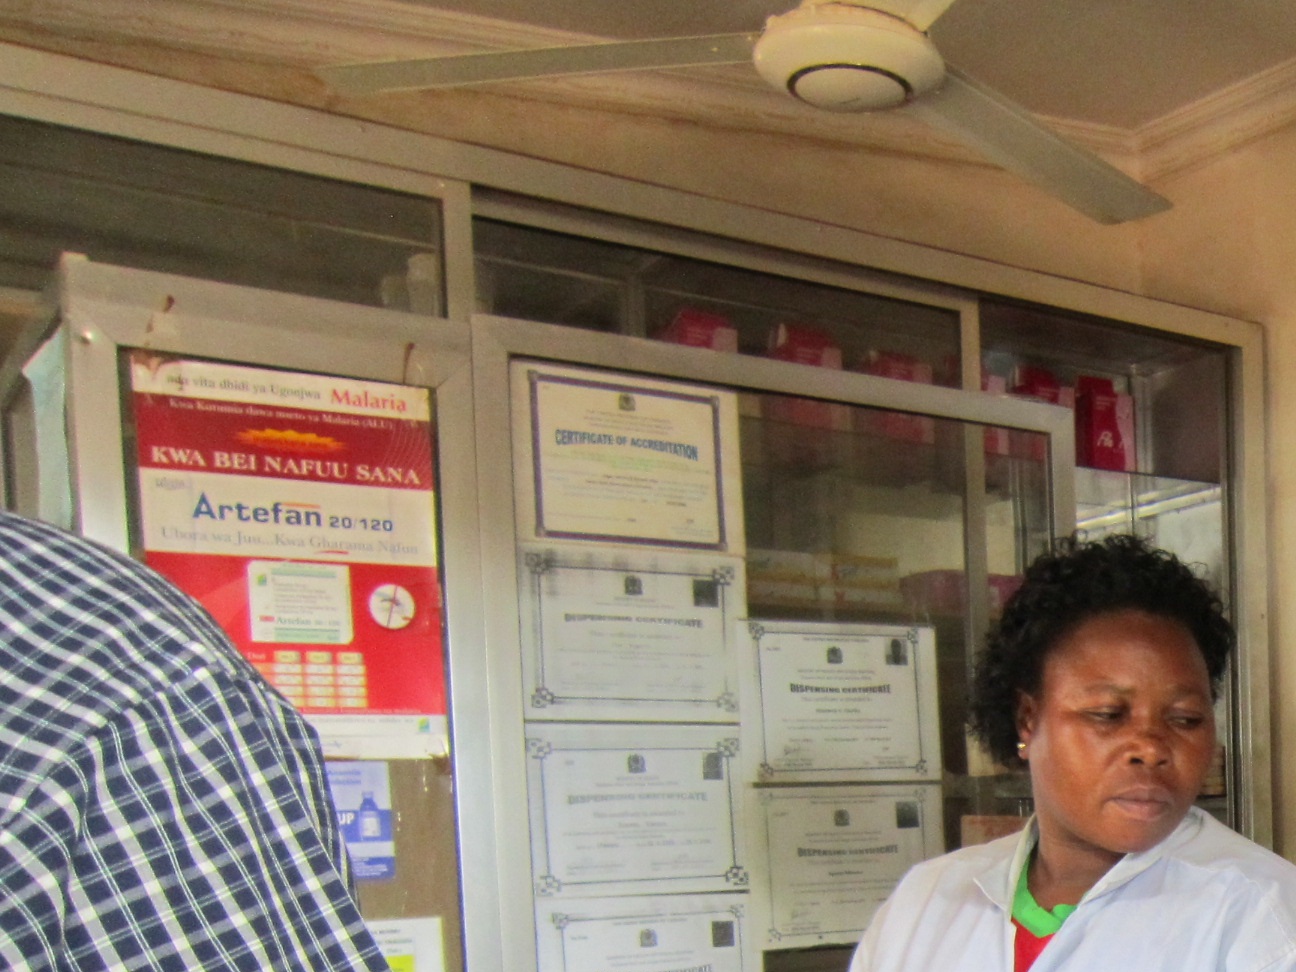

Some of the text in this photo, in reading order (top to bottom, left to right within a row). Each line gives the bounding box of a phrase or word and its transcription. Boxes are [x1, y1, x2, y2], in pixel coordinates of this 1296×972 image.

[330, 387, 408, 413] Malaria
[555, 429, 699, 461] CERTIFICATE OF ACCREDITATION
[151, 445, 421, 485] KWA BEI NAFUU SANA
[192, 491, 322, 527] Artefan
